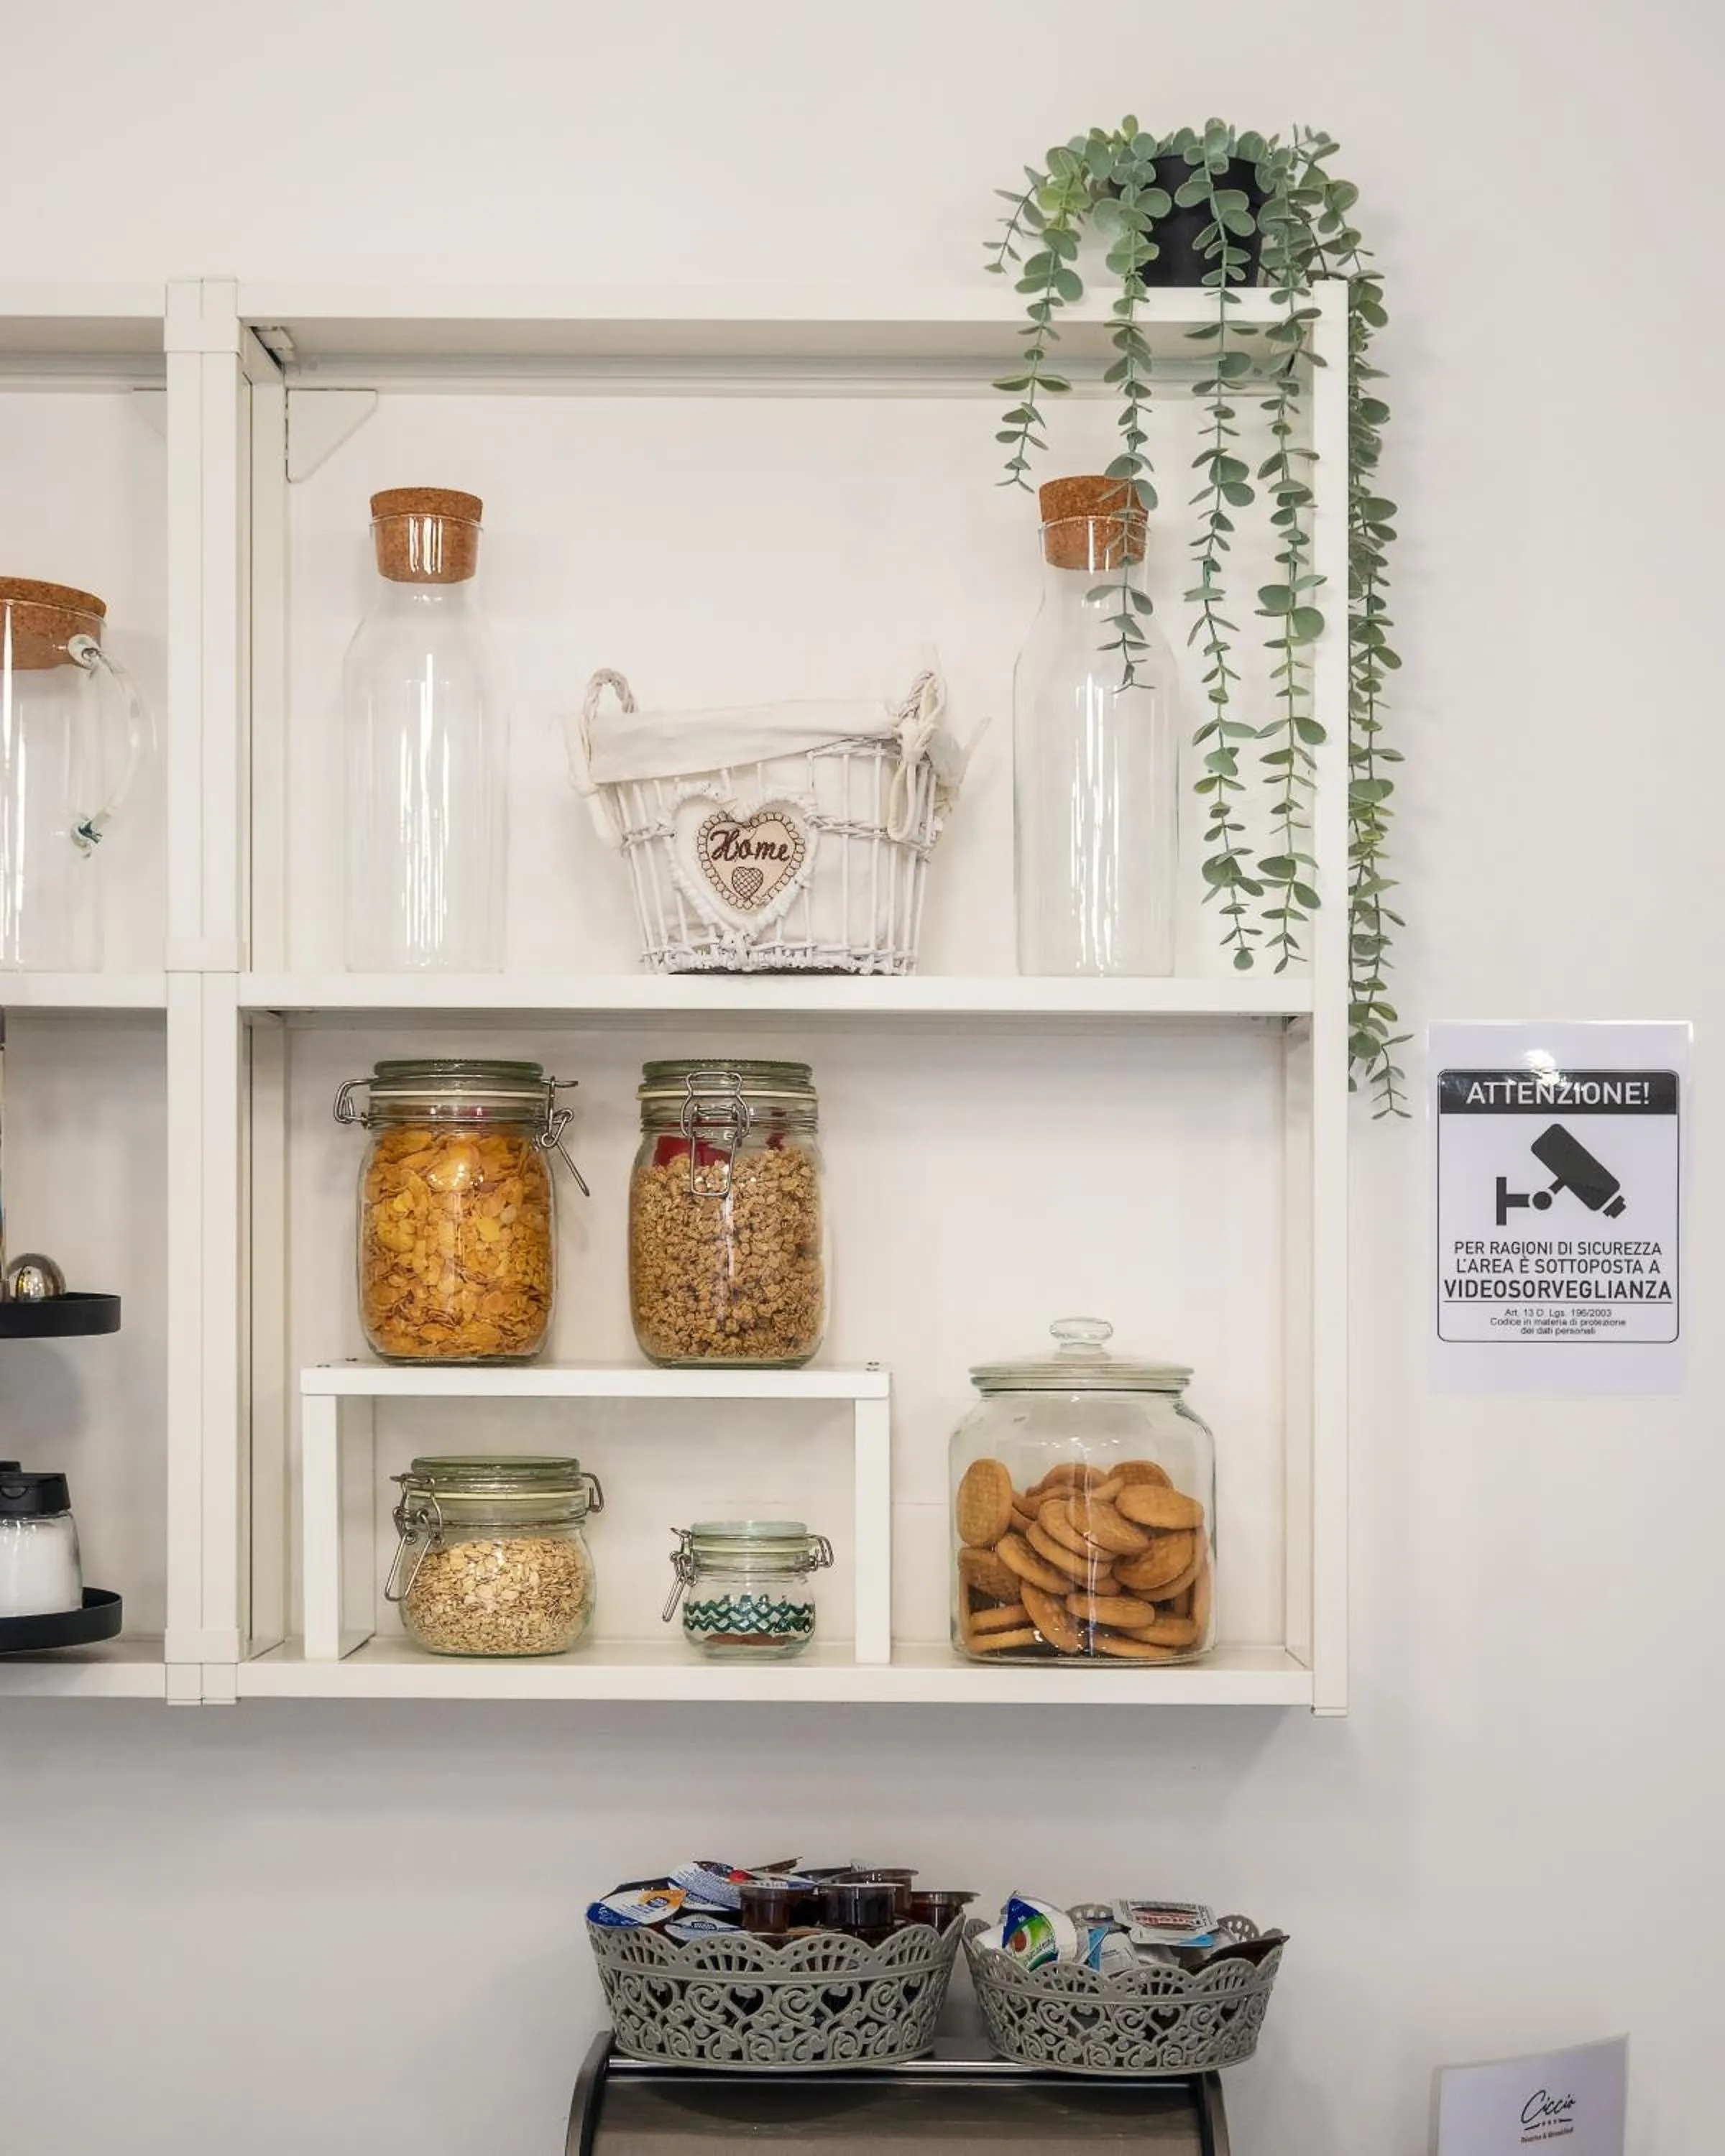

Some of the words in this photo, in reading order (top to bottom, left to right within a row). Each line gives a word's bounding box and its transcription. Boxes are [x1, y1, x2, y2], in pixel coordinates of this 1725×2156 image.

[710, 829, 790, 862] Home
[1466, 1082, 1650, 1105] ATTENZIONE!
[1455, 1241, 1484, 1255] PER
[1490, 1241, 1552, 1255] RAGIONI
[1558, 1241, 1572, 1255] DI
[1578, 1241, 1662, 1256] SICUREZZA
[1457, 1258, 1514, 1273] L'AREA
[1520, 1256, 1530, 1273] È
[1535, 1258, 1644, 1274] SOTTOPOSTA
[1649, 1259, 1661, 1274] A
[1445, 1279, 1672, 1299] VIDEOSORVEGLIANZA
[1580, 1318, 1626, 1327] protezione
[1555, 1327, 1596, 1337] personali
